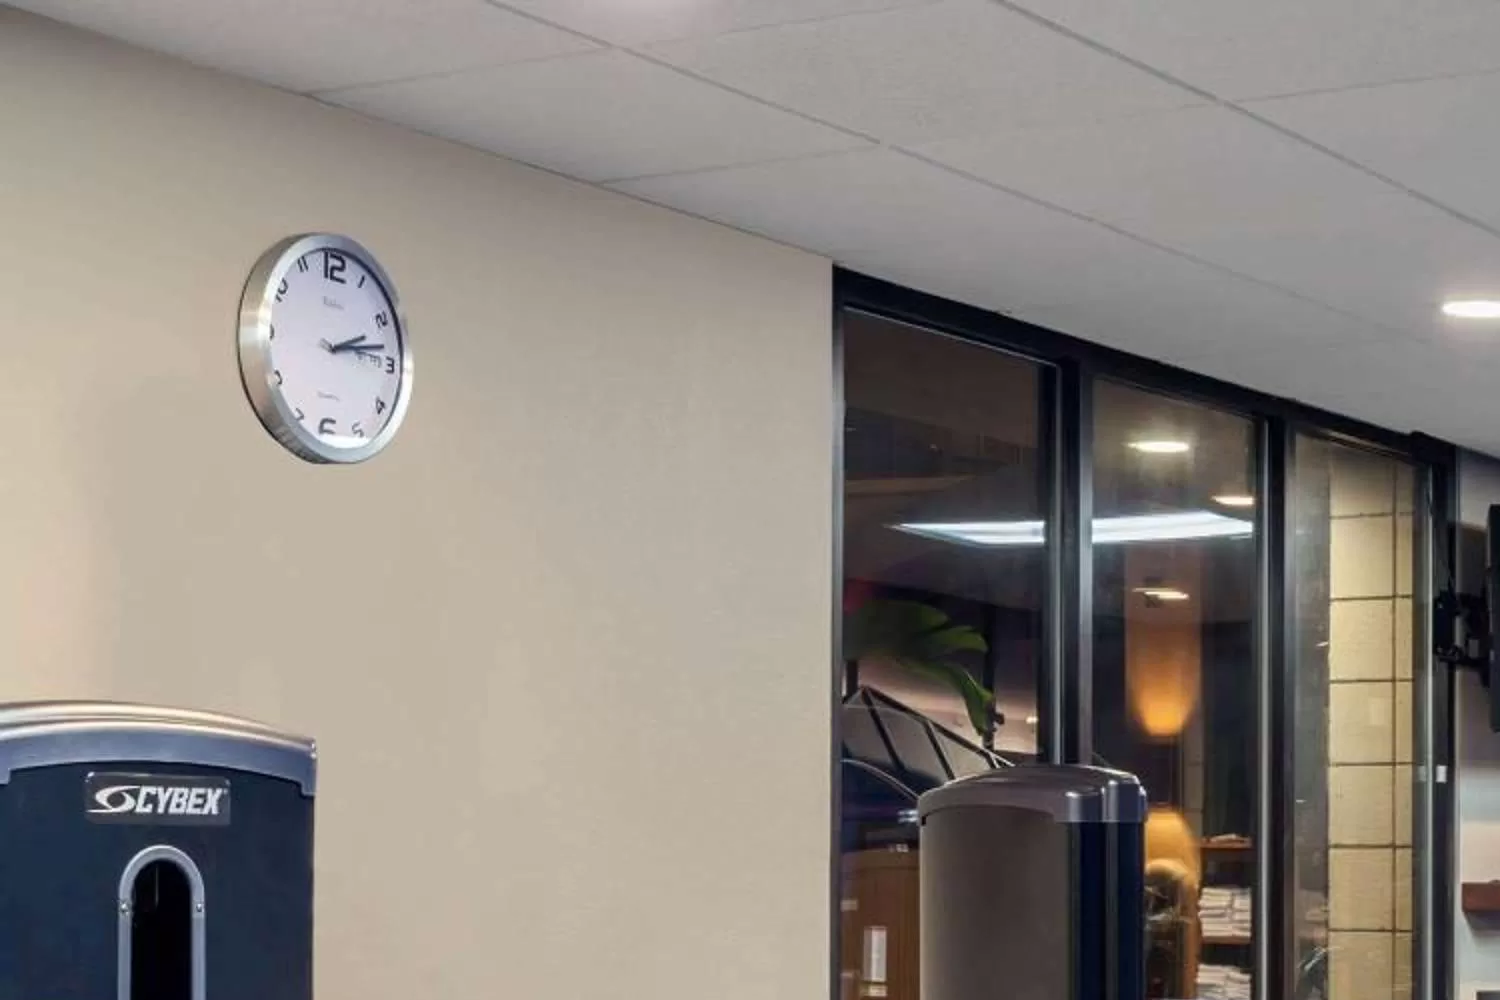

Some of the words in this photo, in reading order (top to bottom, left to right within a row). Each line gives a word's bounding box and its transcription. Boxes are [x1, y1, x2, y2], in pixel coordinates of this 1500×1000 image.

[324, 251, 346, 284] 12
[358, 275, 366, 289] 1
[375, 311, 388, 328] 2
[385, 356, 395, 374] 3
[375, 397, 386, 414] 4
[351, 422, 364, 438] 5
[135, 786, 222, 815] CYBEX
